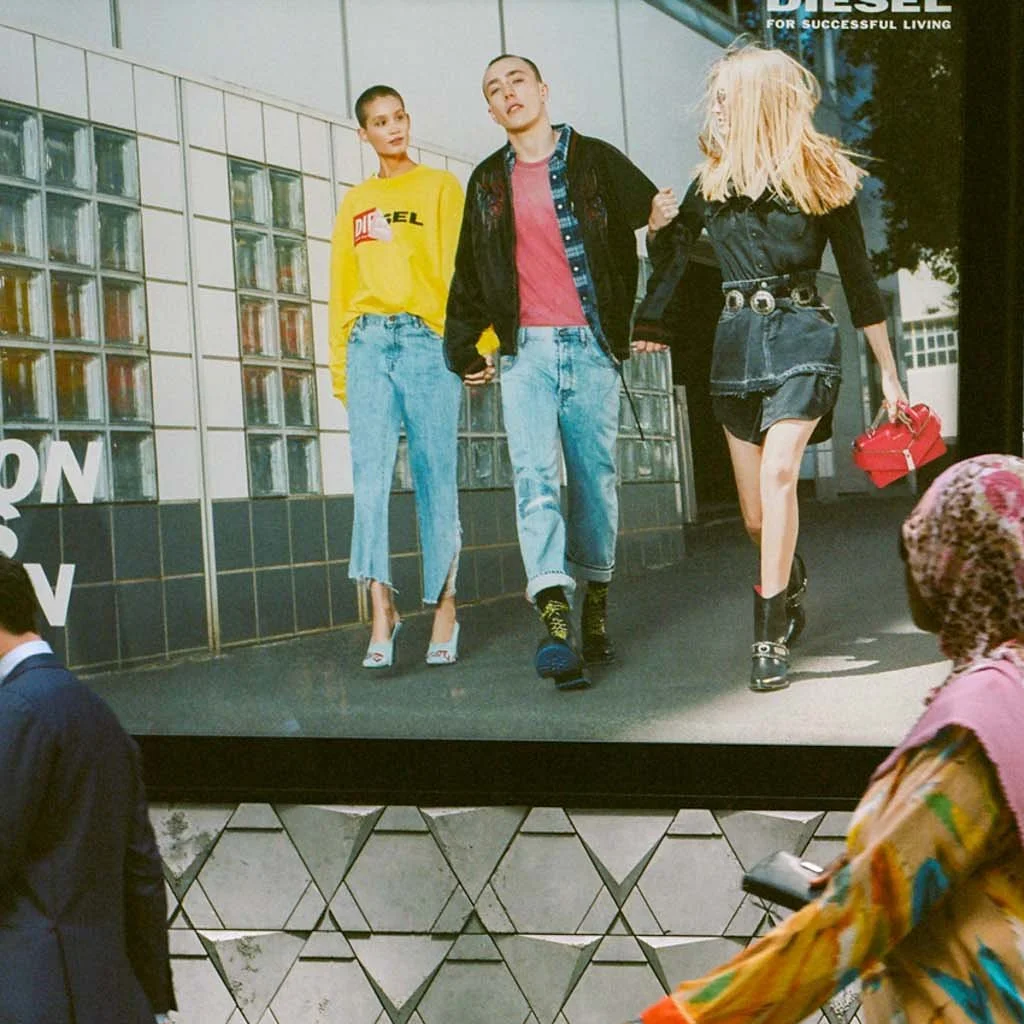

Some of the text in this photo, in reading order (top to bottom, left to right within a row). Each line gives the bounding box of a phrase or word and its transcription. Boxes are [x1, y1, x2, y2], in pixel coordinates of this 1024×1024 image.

[766, 19, 952, 30] FOR SUCCESSFUL LIVING
